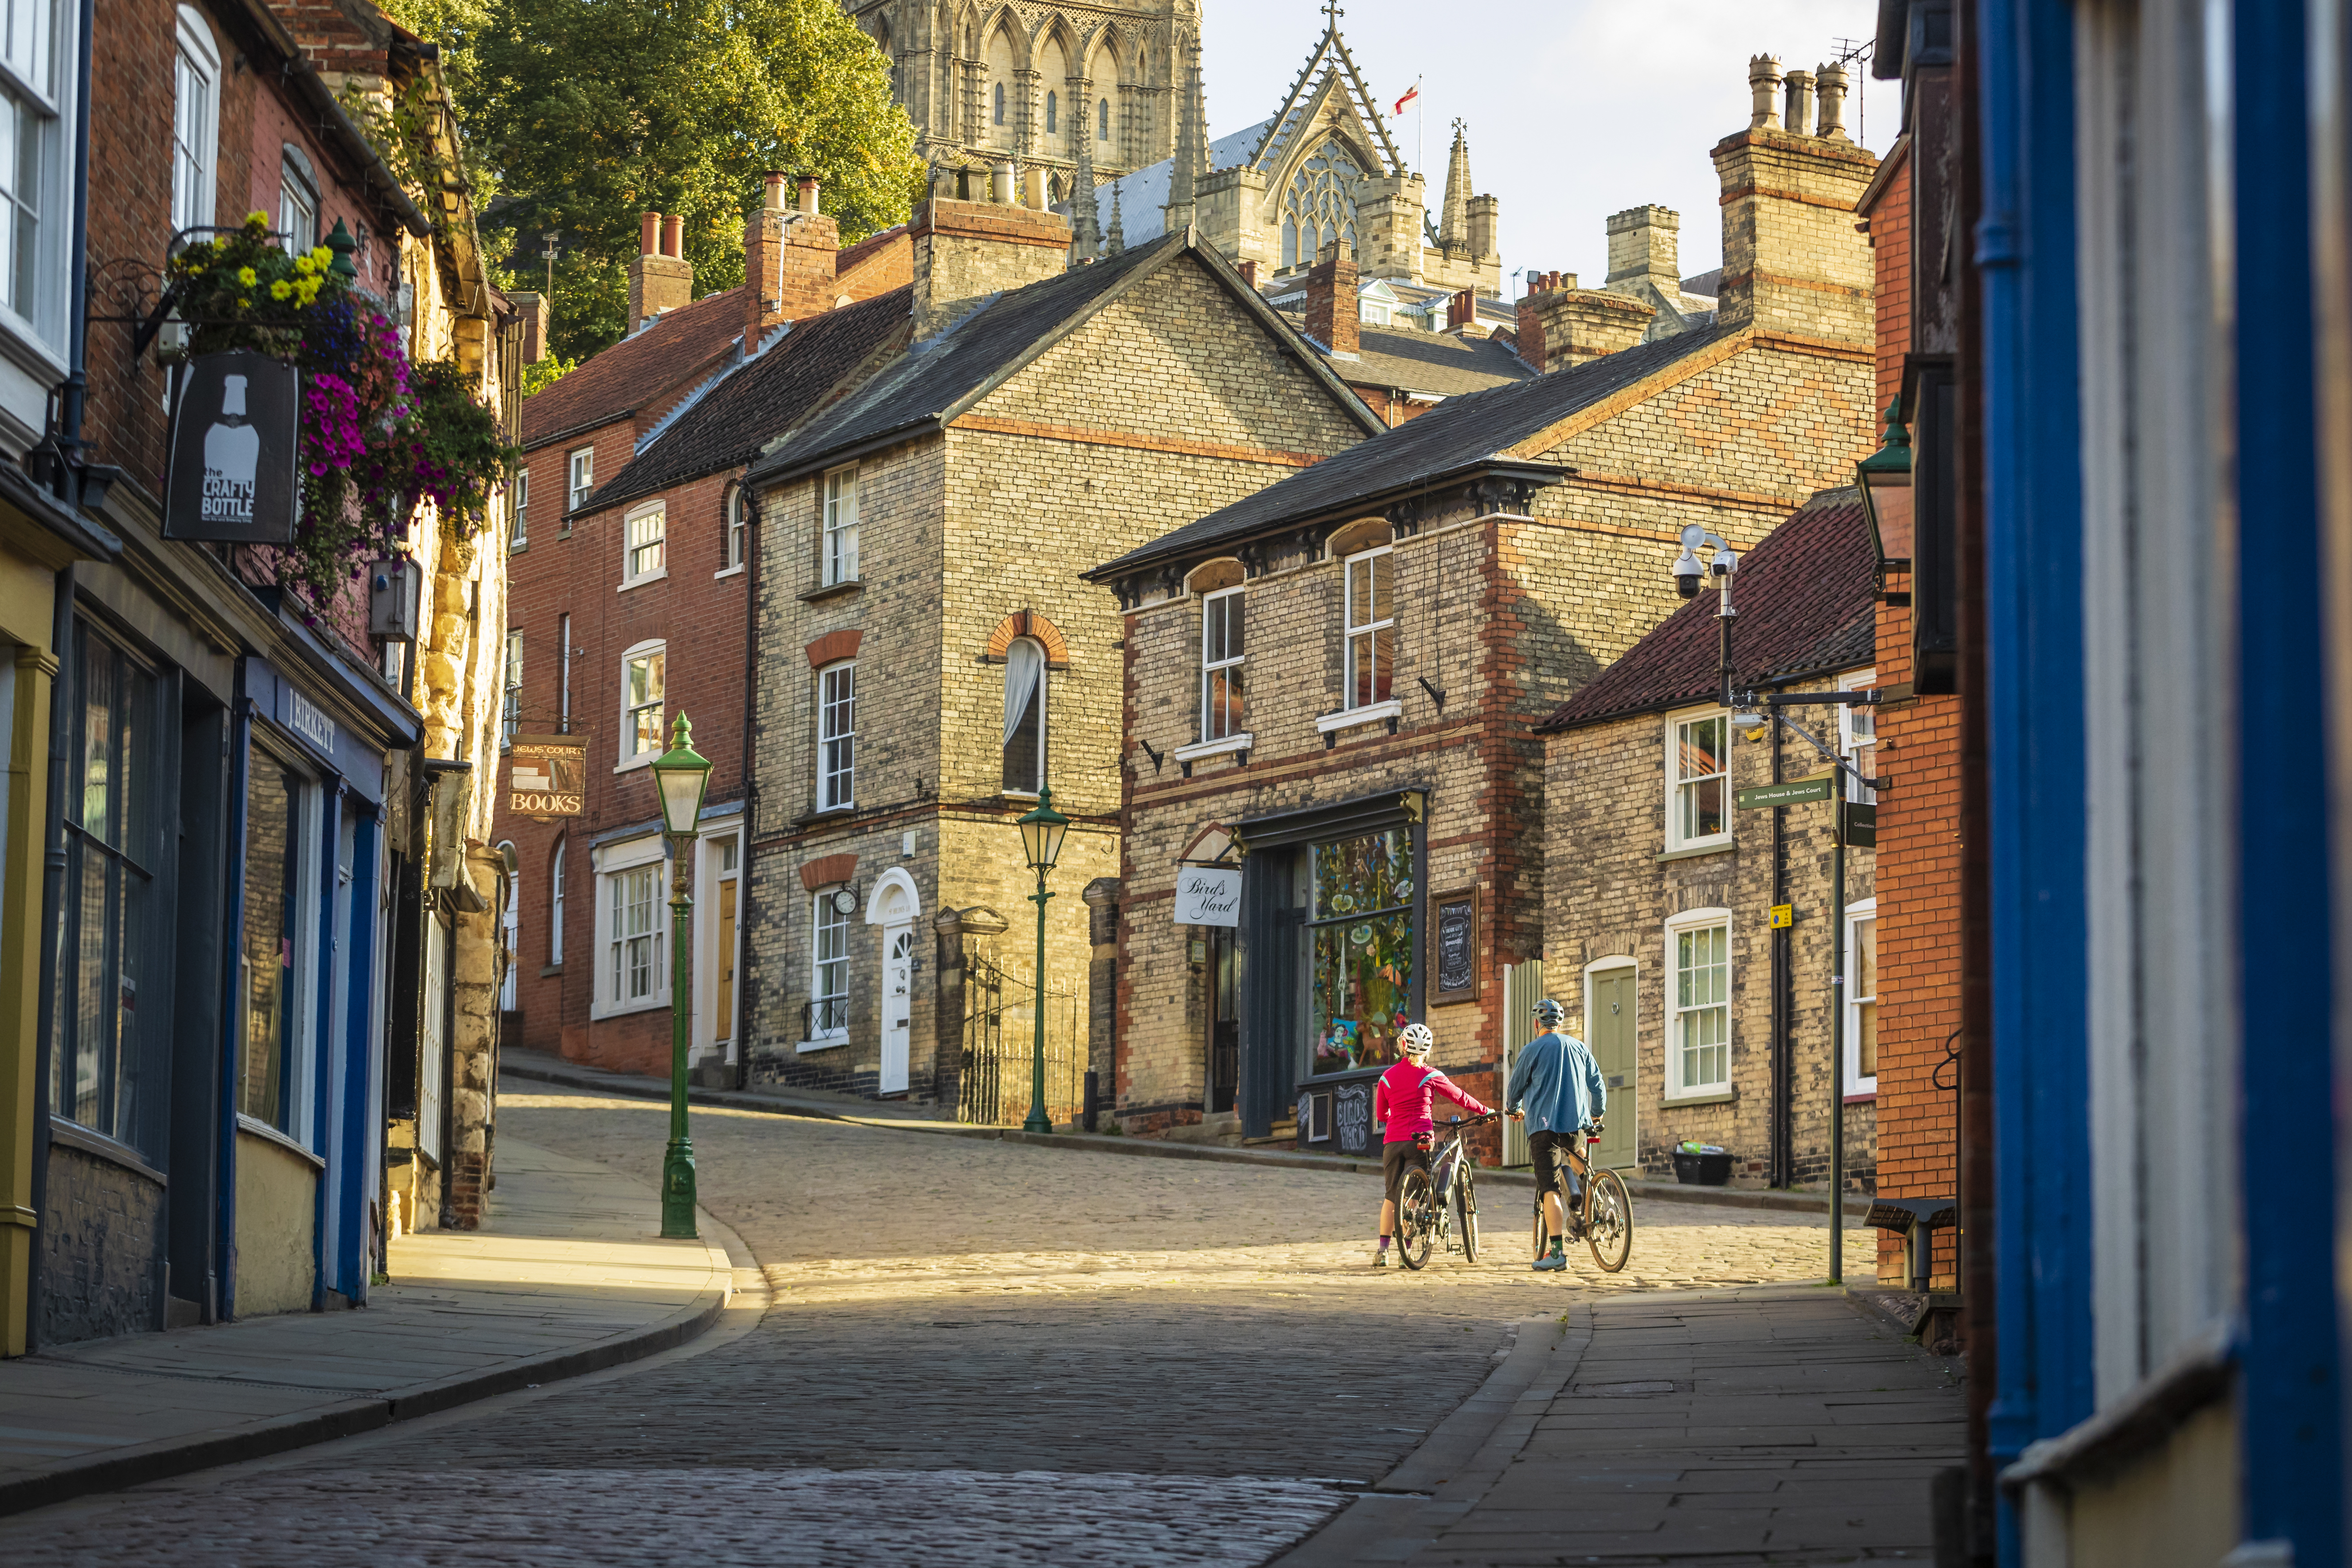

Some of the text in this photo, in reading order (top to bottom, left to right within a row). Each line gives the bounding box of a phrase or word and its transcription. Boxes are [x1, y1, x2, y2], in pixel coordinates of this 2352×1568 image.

[205, 467, 223, 477] the
[203, 479, 255, 498] CRAFTY
[202, 497, 254, 517] BOTTLE
[295, 692, 335, 755] BIRKETT
[547, 746, 584, 755] COURT
[511, 793, 581, 812] BOOKS
[1183, 877, 1227, 897] Bird's
[1192, 895, 1238, 919] Yard
[1337, 1098, 1368, 1127] BIRDS
[1340, 1124, 1367, 1151] YARD
